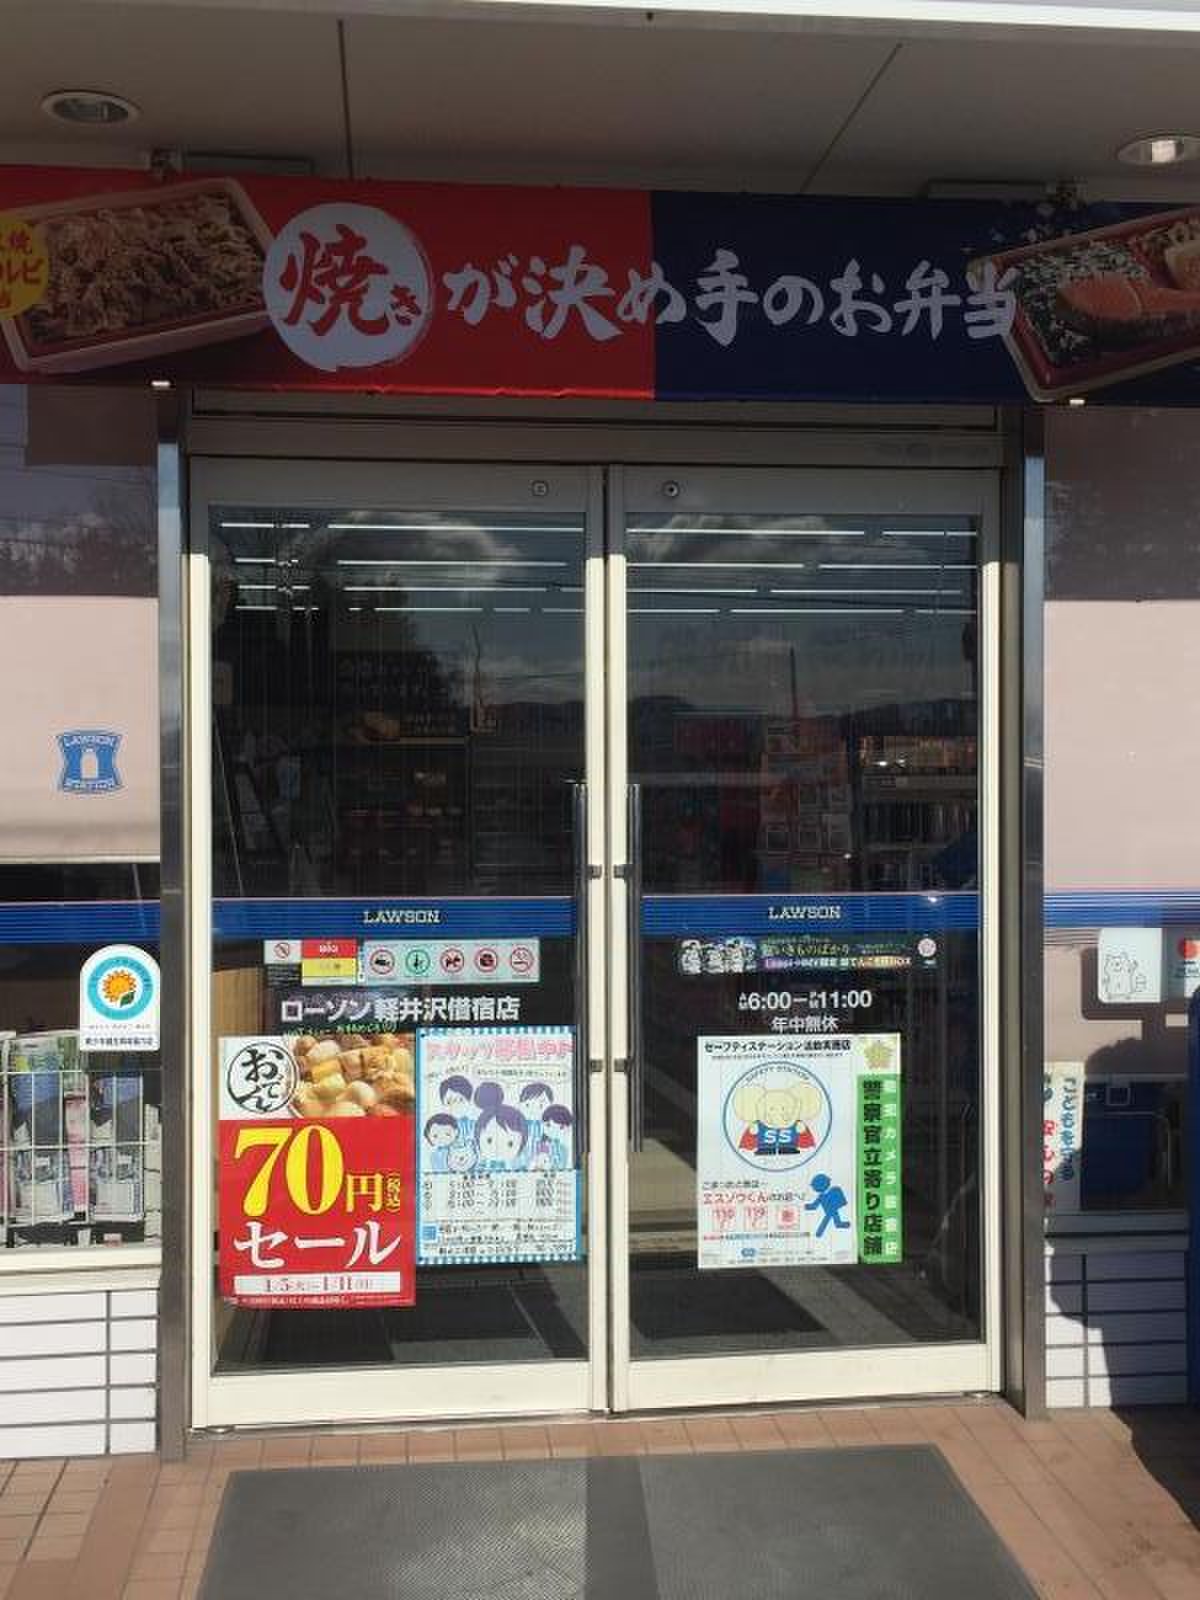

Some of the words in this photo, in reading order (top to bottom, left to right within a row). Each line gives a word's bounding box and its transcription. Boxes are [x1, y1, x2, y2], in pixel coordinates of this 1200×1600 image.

[363, 909, 441, 925] LAWSON
[767, 905, 842, 920] LAWSON
[233, 1220, 401, 1269] セール
